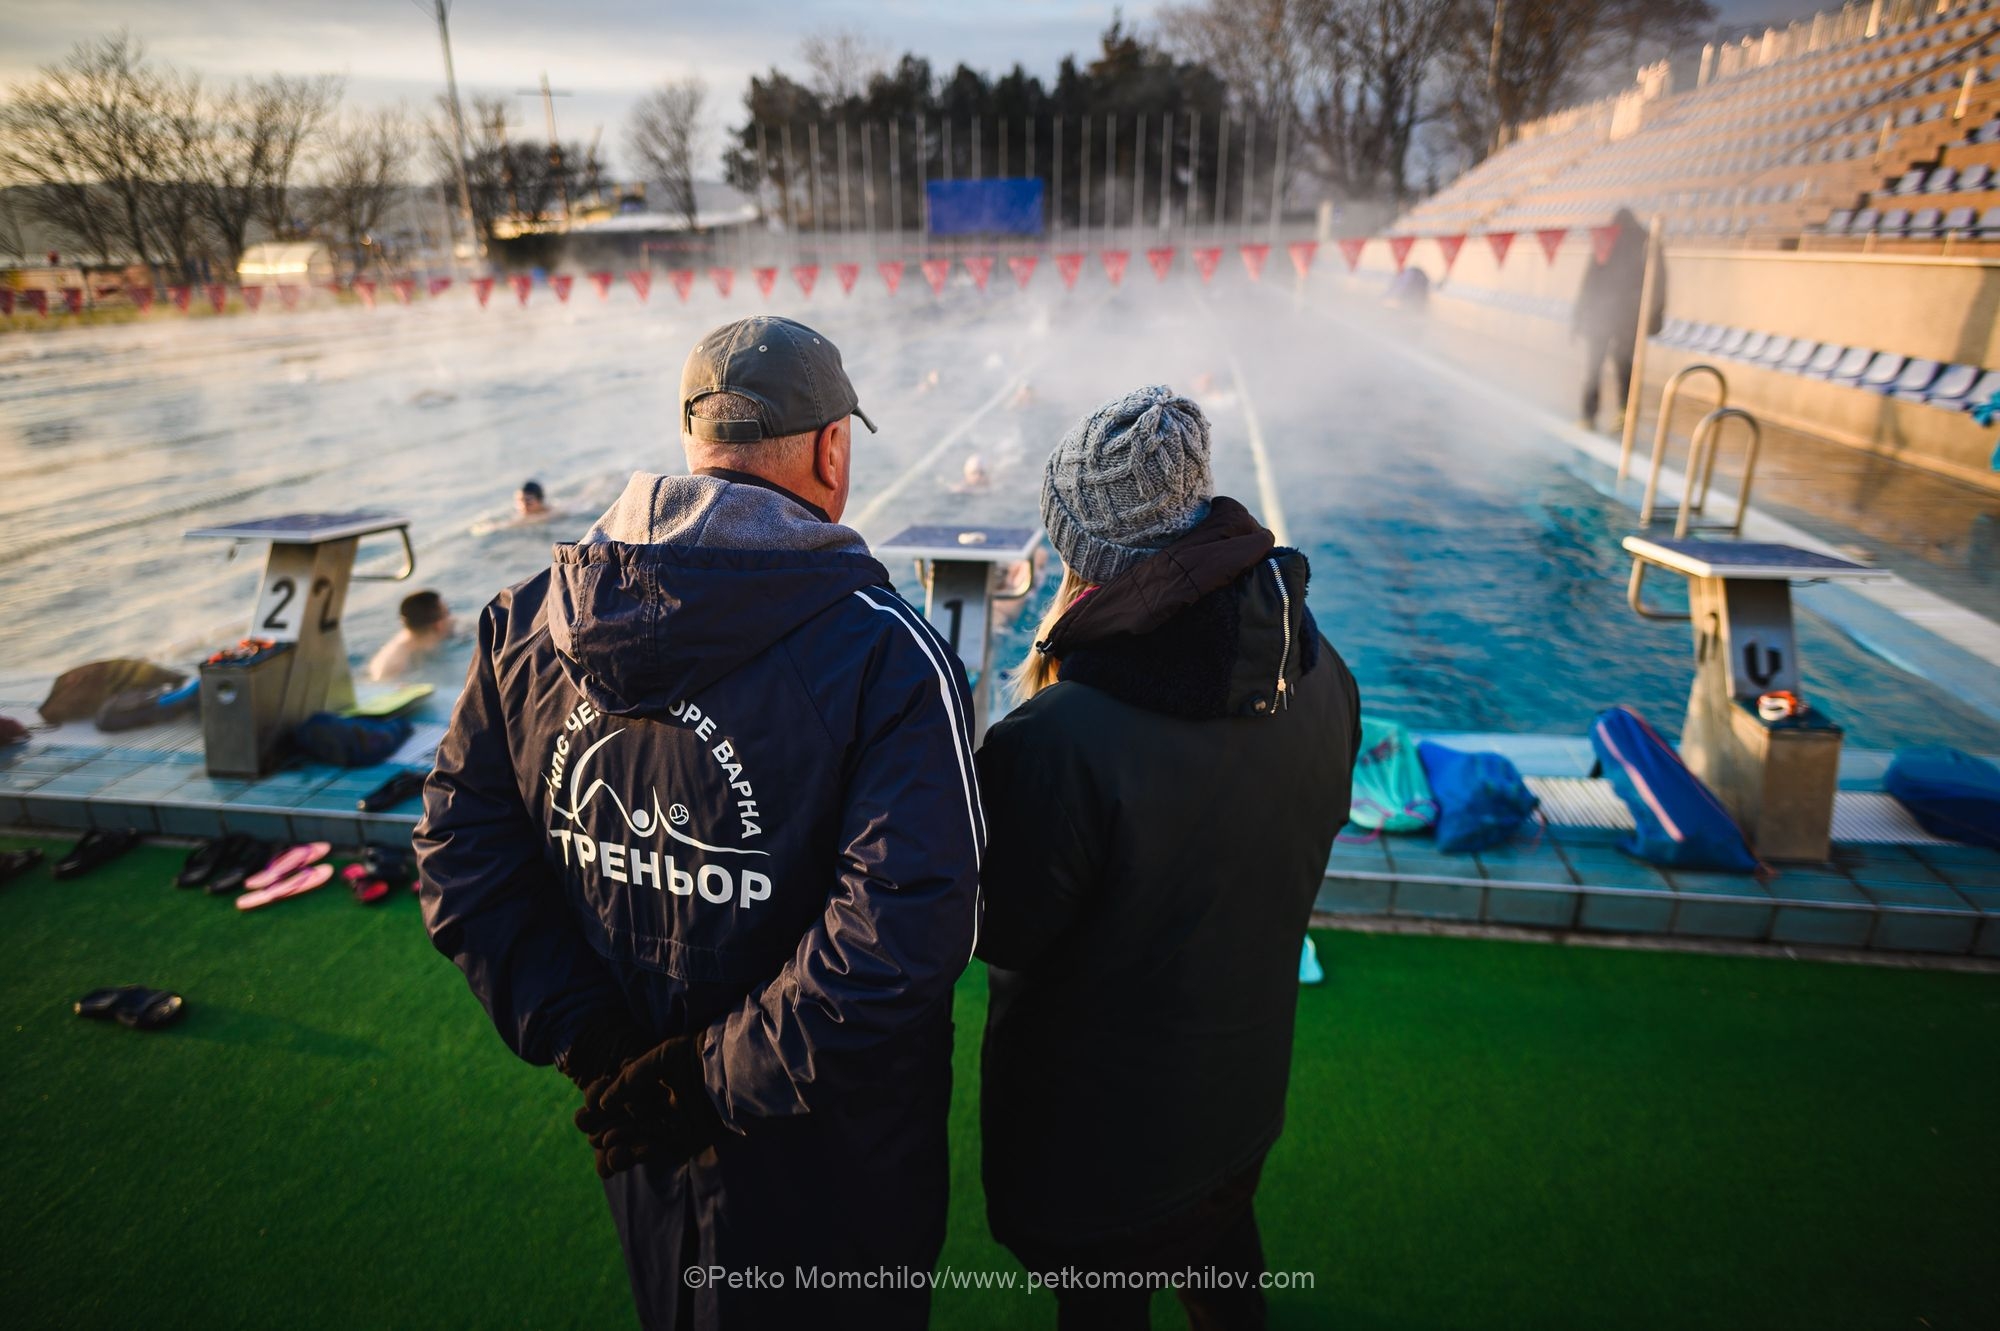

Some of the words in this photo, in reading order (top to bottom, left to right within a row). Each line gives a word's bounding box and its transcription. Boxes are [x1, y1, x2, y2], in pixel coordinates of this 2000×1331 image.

[263, 578, 295, 628] 2
[313, 577, 338, 632] 2
[944, 600, 963, 653] 1
[552, 735, 569, 789] КПС
[565, 701, 600, 731] ЧЕ
[668, 700, 717, 742] ОРЕ
[712, 740, 762, 839] ВАРНА
[550, 829, 772, 909] ТРЕНЬОР
